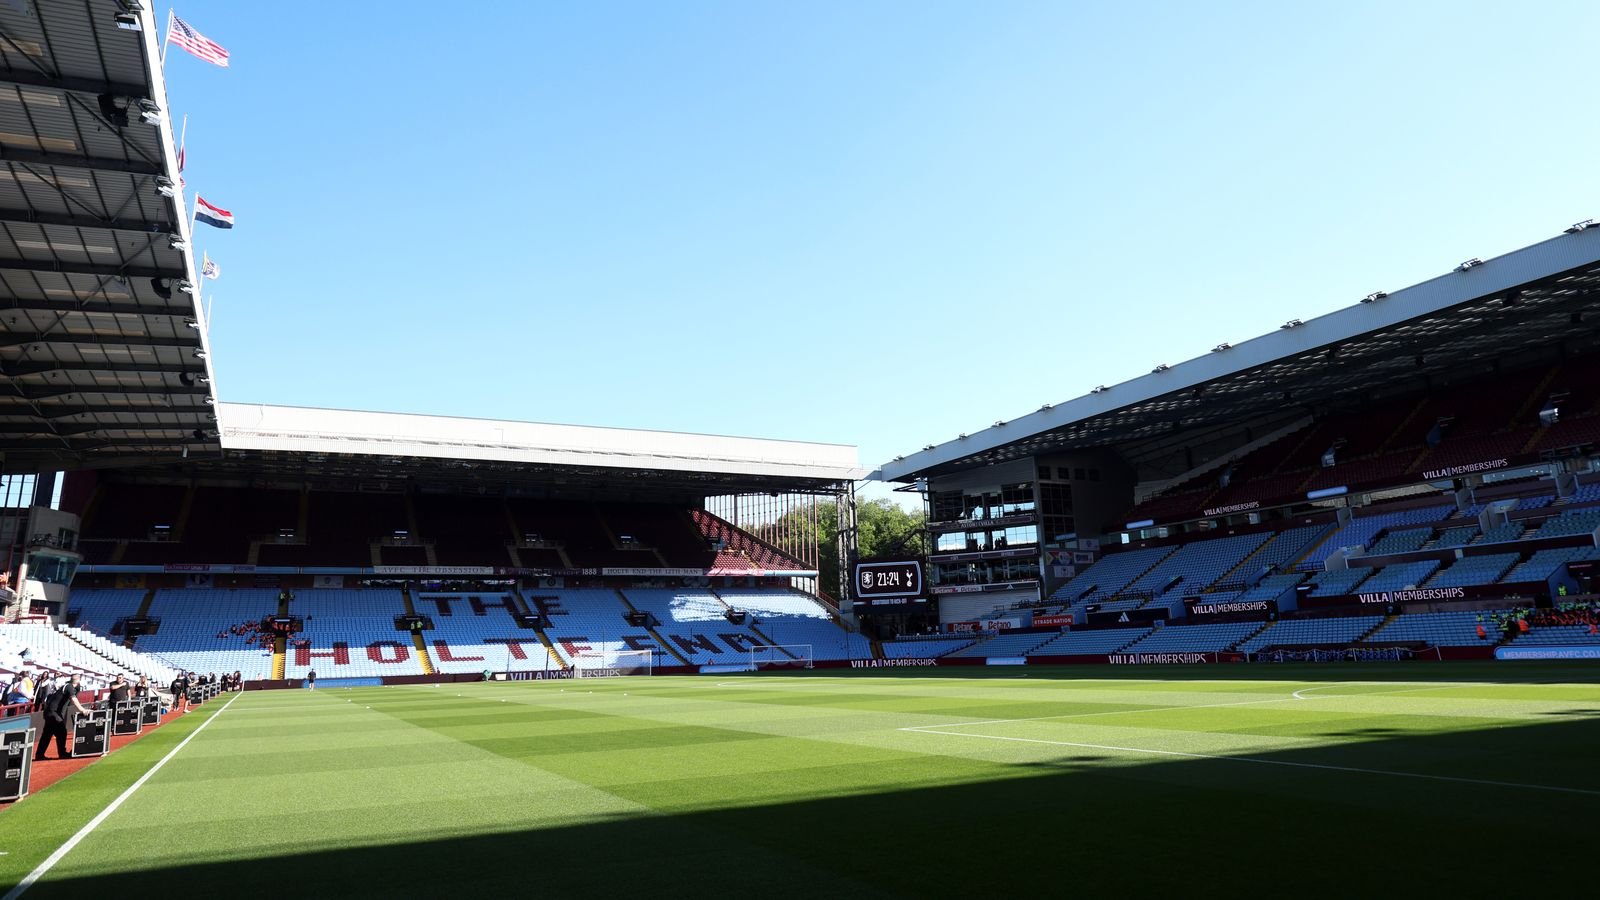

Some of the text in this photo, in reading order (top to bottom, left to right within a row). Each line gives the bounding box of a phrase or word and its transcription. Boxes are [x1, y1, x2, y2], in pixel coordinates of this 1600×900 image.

[1423, 458, 1508, 479] VILLA MEMBERSHIPS
[1203, 501, 1260, 516] VILLA MEMBERSHIPS
[434, 566, 486, 575] OBSESSION
[877, 571, 900, 586] 21:24
[1359, 587, 1465, 603] VILLA MEMBERSHIPS
[419, 596, 569, 618] THE
[1192, 601, 1268, 614] VILLA MEMBERSHIPS
[851, 658, 938, 668] VILLA MEMBERSHIPS
[1108, 653, 1207, 664] VILLA MEMBERSHIPS
[510, 672, 542, 681] VILLA
